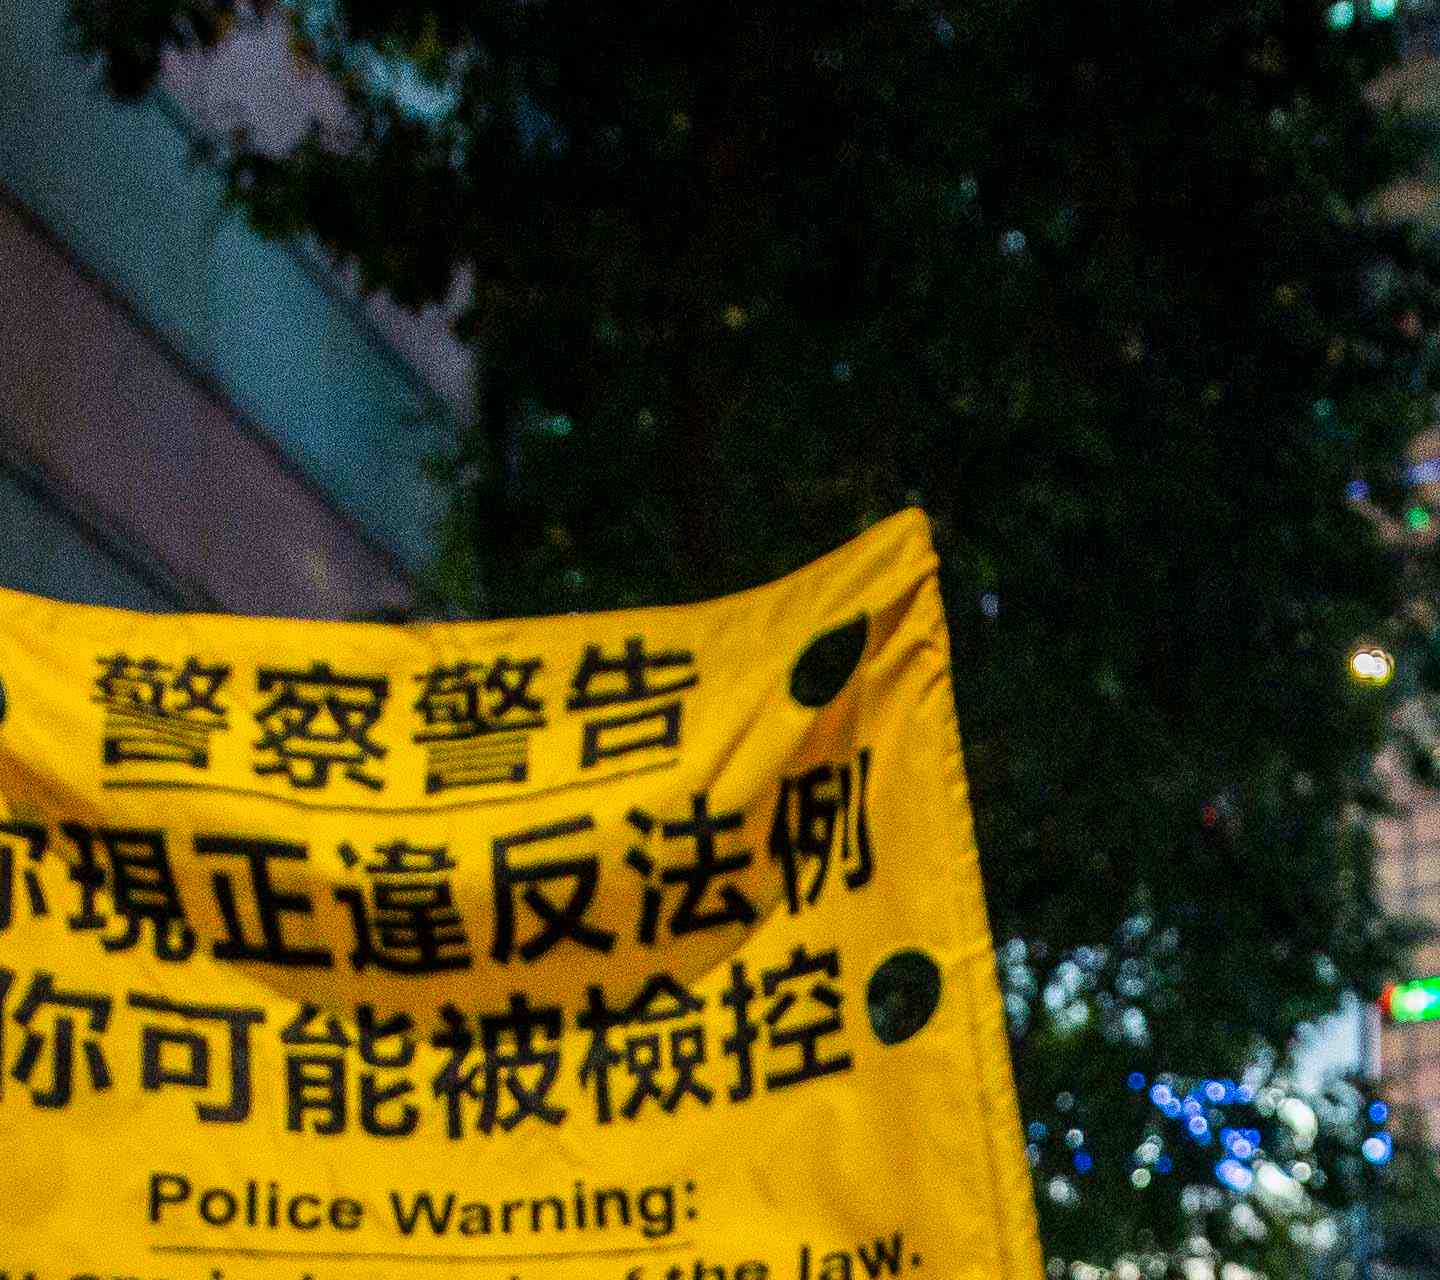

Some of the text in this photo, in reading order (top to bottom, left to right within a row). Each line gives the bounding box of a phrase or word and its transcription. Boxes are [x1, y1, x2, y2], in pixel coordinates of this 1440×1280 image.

[93, 637, 701, 795] 警察警告
[147, 1172, 698, 1239] Police Warning:
